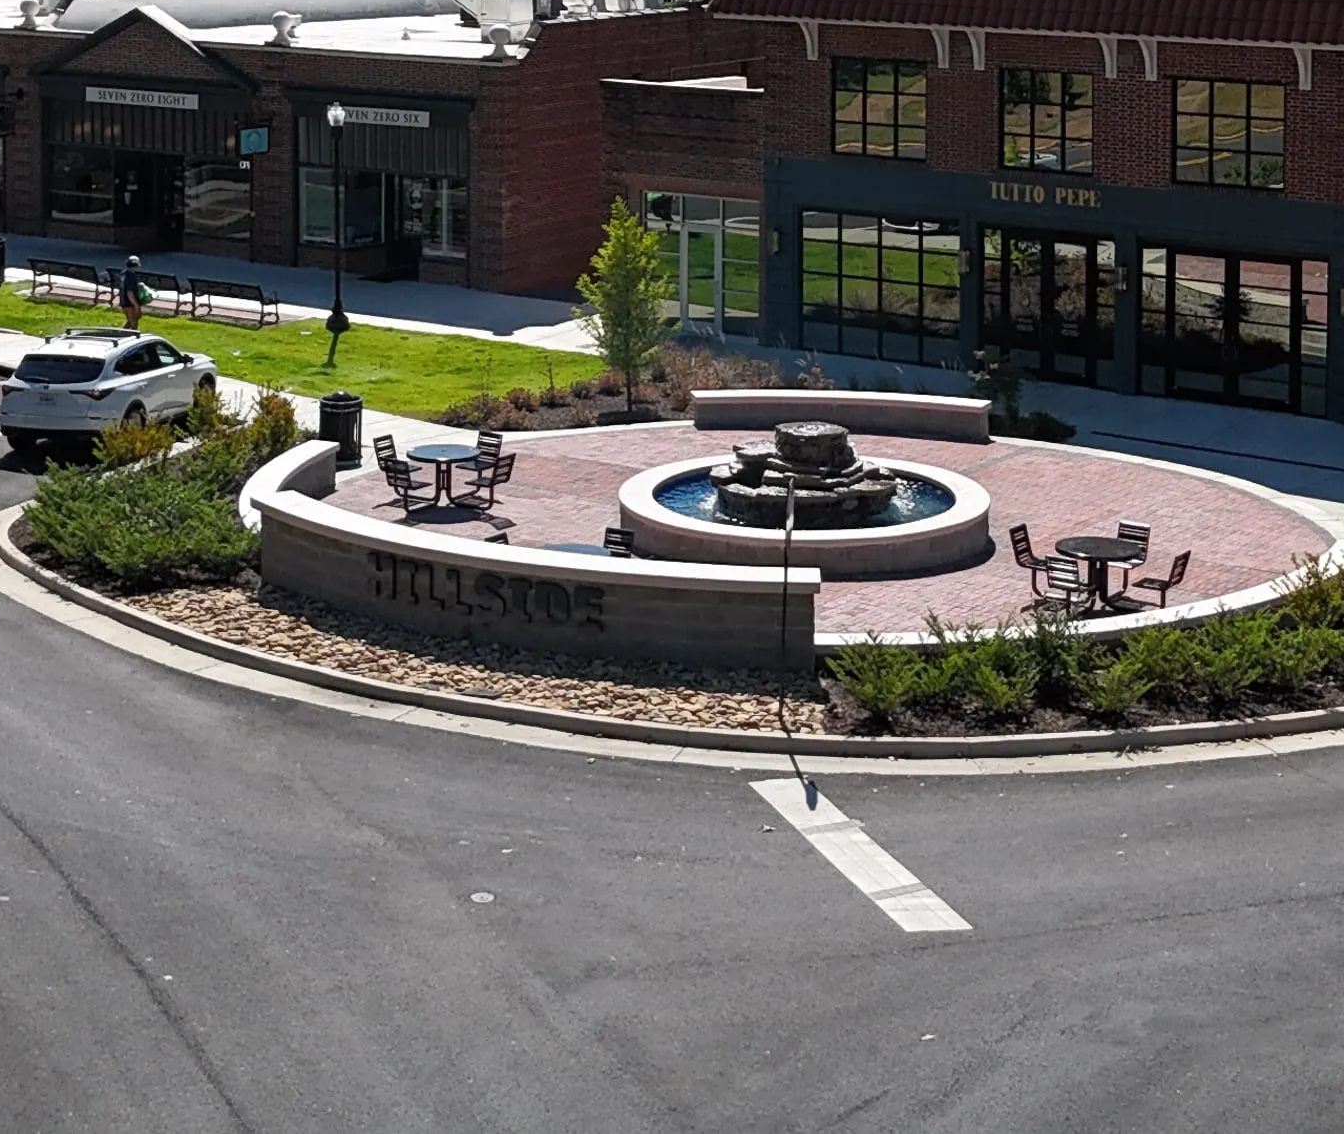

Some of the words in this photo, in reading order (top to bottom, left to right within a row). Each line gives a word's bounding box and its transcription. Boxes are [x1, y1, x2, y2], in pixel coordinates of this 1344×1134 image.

[97, 90, 127, 102] SEVEN
[130, 92, 154, 104] ZERO
[157, 94, 188, 107] EIGHT
[345, 109, 369, 120] VEN
[372, 111, 400, 123] ZERO
[403, 113, 420, 124] SIX
[988, 180, 1045, 204] TUTTO
[1055, 186, 1101, 208] PEPE
[366, 550, 606, 634] HILLSIDE
